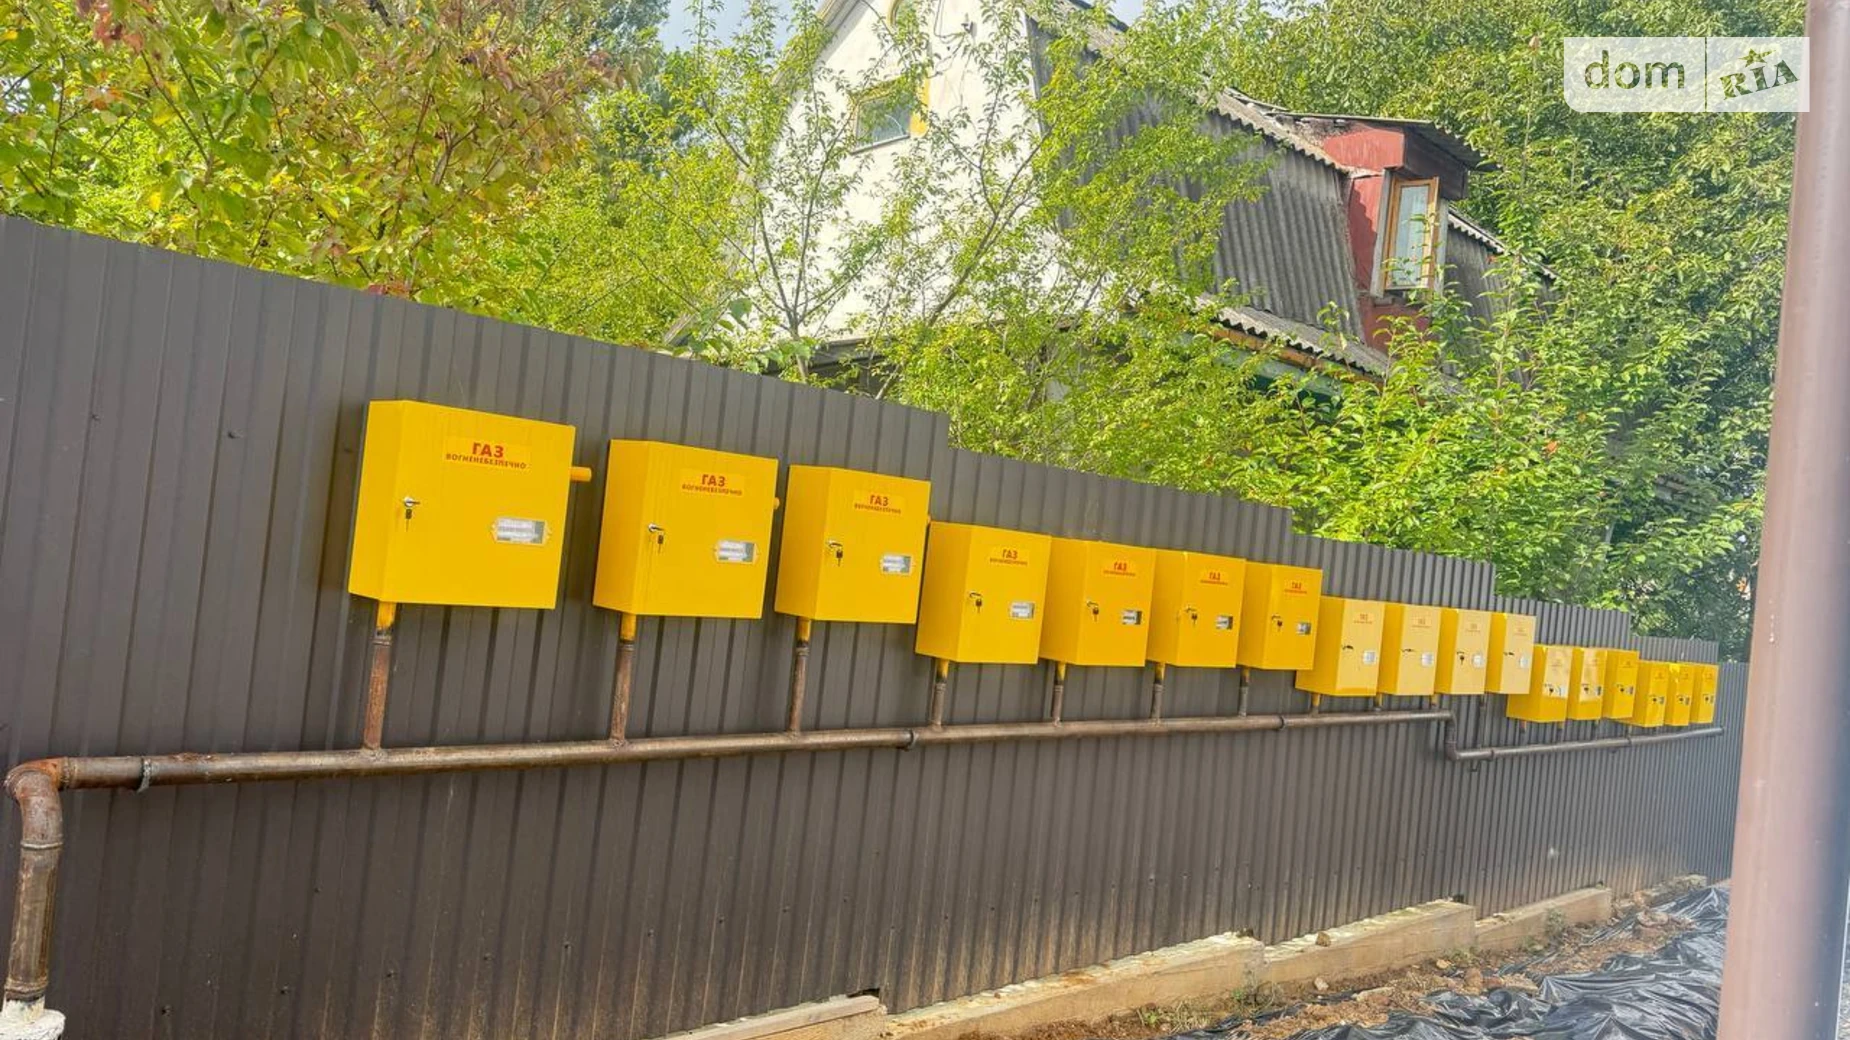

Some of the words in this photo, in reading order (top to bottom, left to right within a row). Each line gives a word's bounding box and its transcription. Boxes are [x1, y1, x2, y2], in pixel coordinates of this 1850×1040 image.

[472, 442, 504, 458] ГАЗ
[445, 453, 527, 470] ВОГНЕНЕБЕЗПЕЧНО
[701, 474, 726, 487] ГАЗ
[869, 494, 889, 507] ГАЗ
[1002, 549, 1018, 560] ГАЗ
